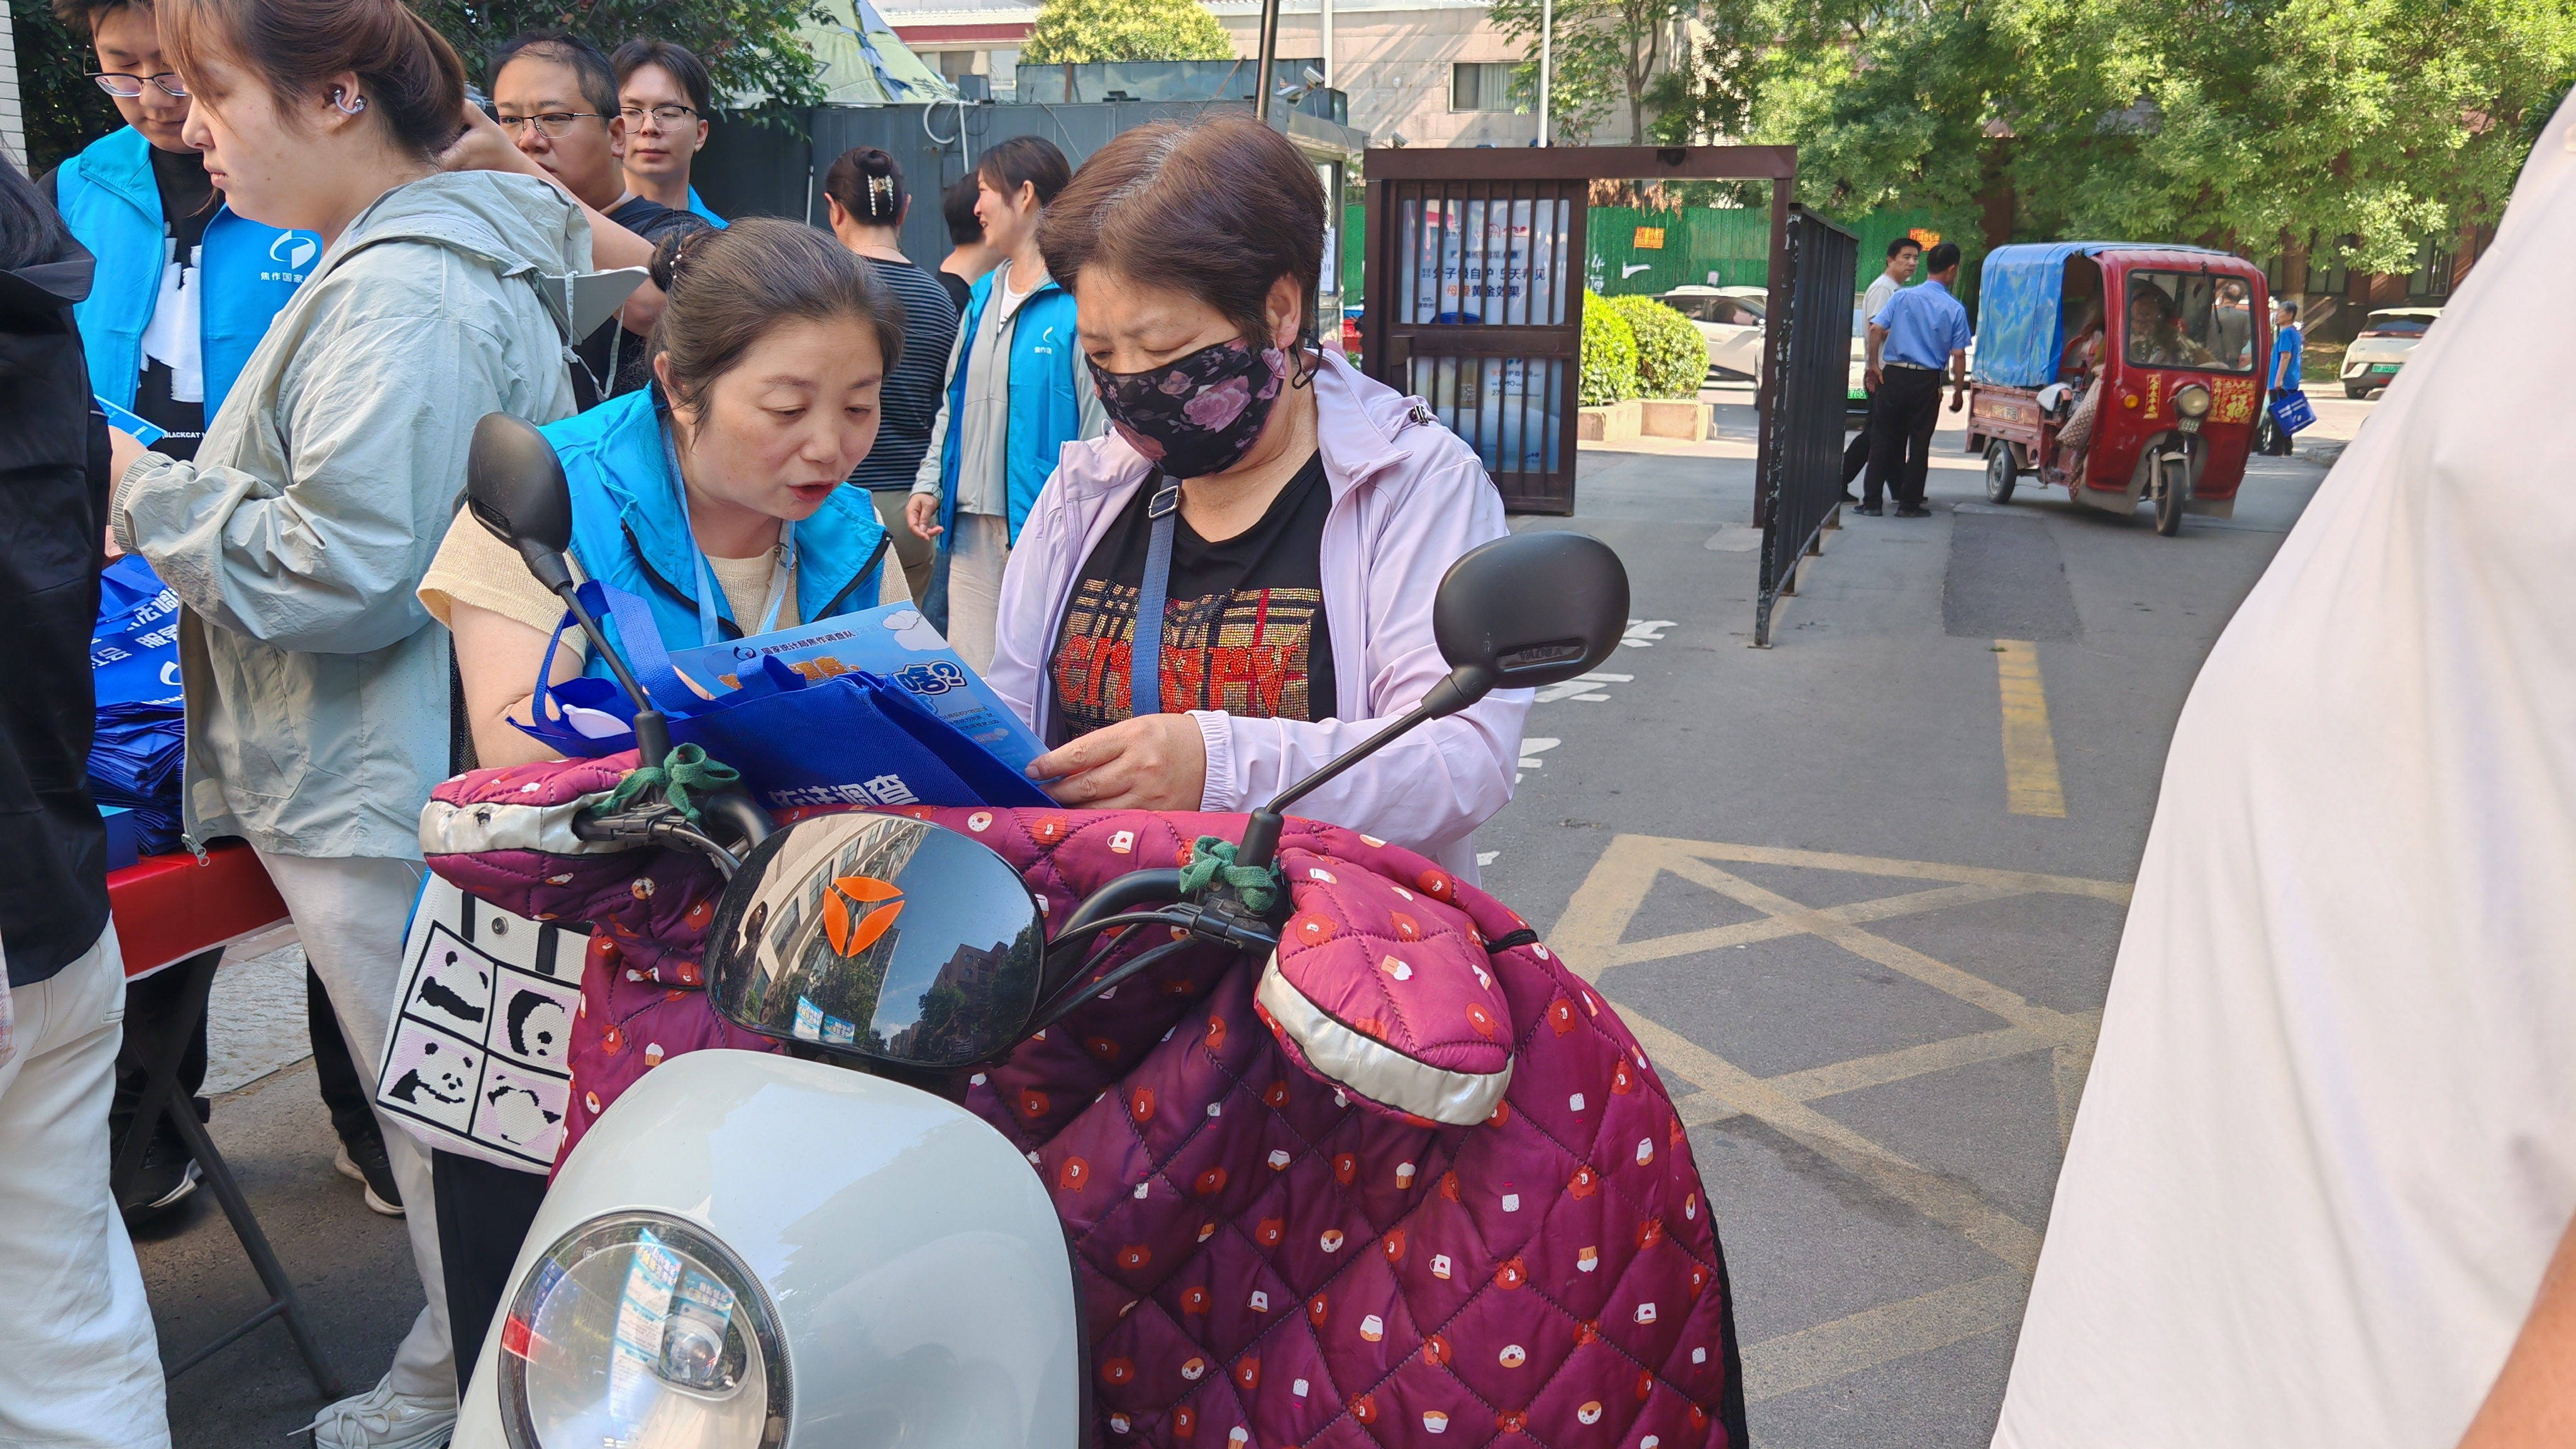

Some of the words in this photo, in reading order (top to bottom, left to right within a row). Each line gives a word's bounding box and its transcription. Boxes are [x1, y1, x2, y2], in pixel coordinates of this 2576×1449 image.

[260, 272, 308, 283] 焦作国家
[760, 630, 856, 655] 国家统计局焦作调查队
